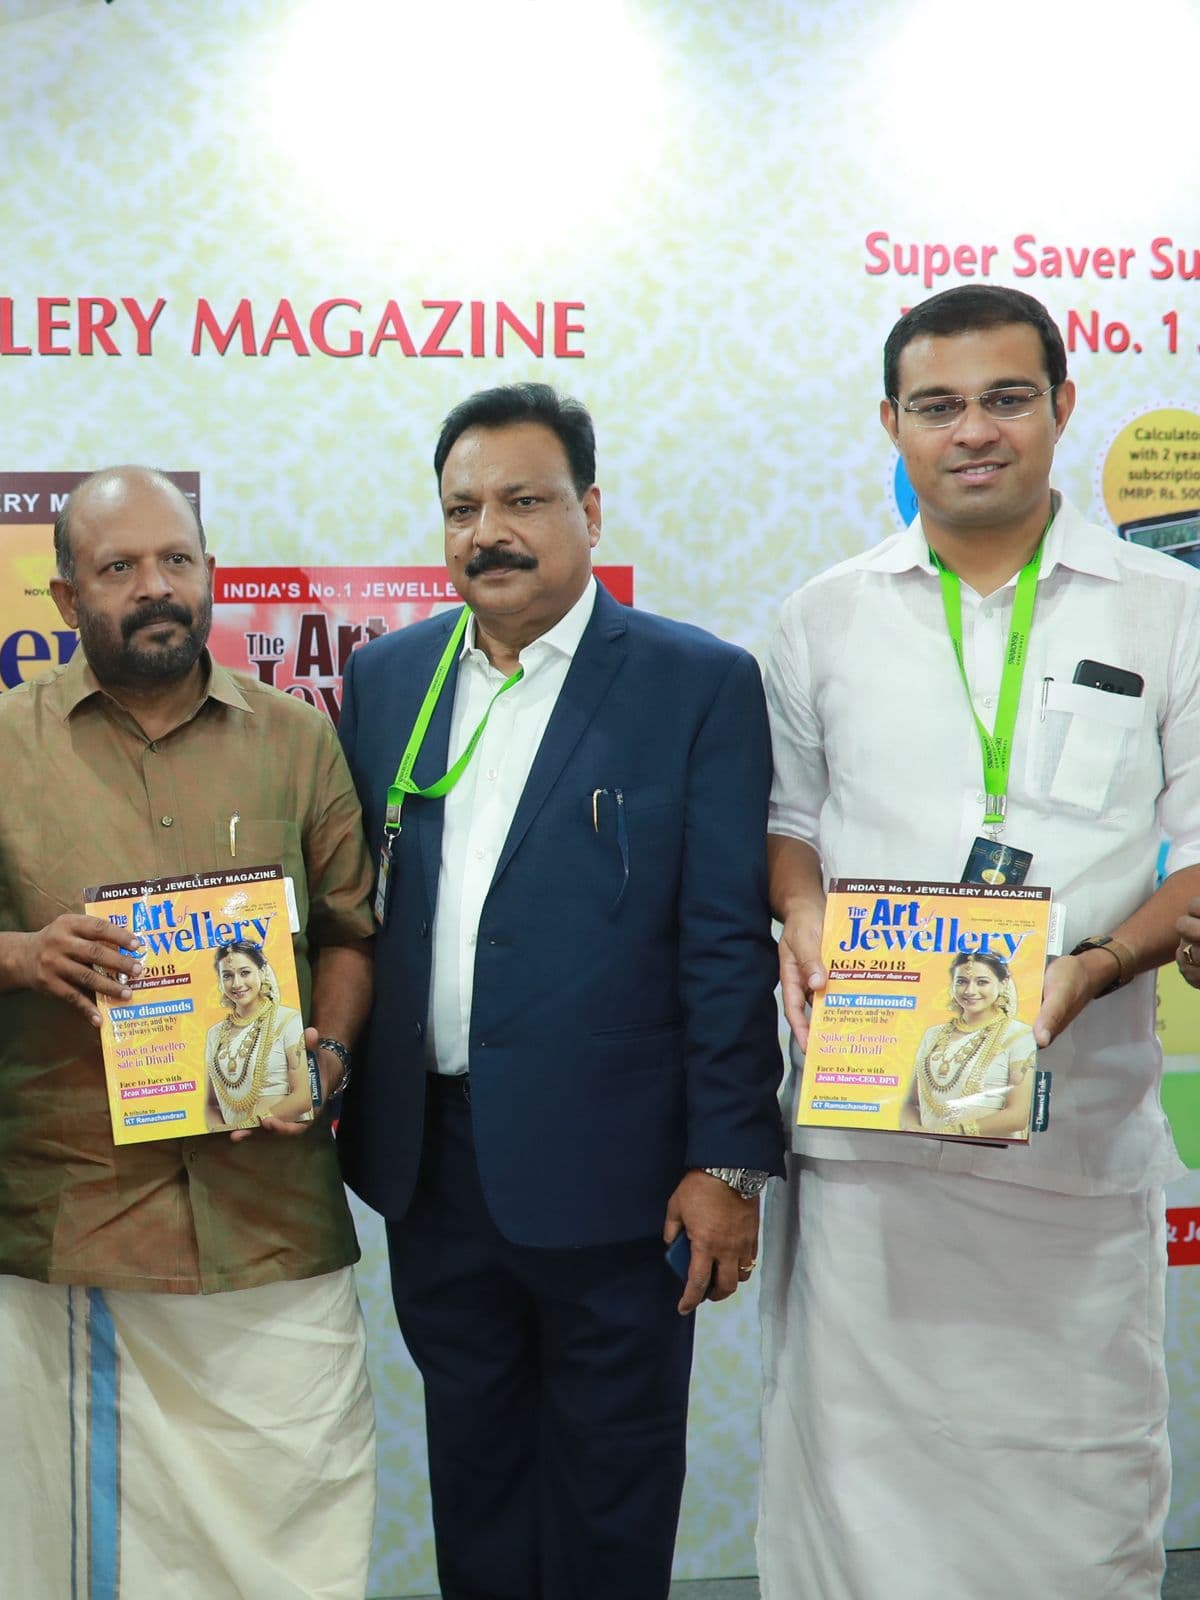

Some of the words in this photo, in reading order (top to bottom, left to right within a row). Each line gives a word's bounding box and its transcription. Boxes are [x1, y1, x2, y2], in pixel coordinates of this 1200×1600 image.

[864, 231, 998, 289] Super
[1012, 234, 1135, 280] Saver
[190, 298, 587, 360] MAGAZINE
[1128, 449, 1159, 461] with
[1162, 448, 1171, 461] 2
[223, 582, 301, 599] INDIA'S
[308, 581, 353, 599] No.1
[246, 632, 285, 657] The
[101, 886, 137, 898] INDIA'S
[140, 884, 162, 894] No.1
[164, 876, 223, 891] JEWELLERY
[224, 870, 277, 884] MAGAZINE
[846, 883, 885, 892] INDIA'S
[888, 885, 911, 893] No.1
[914, 886, 980, 896] JEWELLERY
[982, 889, 1043, 898] MAGAZINE
[108, 912, 127, 925] The
[131, 899, 176, 932] Art
[847, 906, 867, 917] The
[871, 898, 921, 927] Art
[839, 917, 1026, 965] Jewellery
[142, 963, 175, 977] 2018
[830, 958, 865, 970] KGJS
[869, 959, 906, 970] 2018
[111, 1007, 136, 1020] Why
[137, 999, 191, 1016] diamonds
[826, 995, 853, 1006] Why
[854, 995, 914, 1008] diamonds
[849, 1043, 882, 1055] Diwali
[145, 1052, 174, 1066] Diwali
[846, 1065, 866, 1073] Face
[867, 1066, 885, 1074] with
[119, 1079, 137, 1088] Face
[137, 1078, 145, 1086] to
[147, 1076, 165, 1084] Face
[165, 1073, 182, 1082] with
[1035, 1094, 1046, 1125] Diamond
